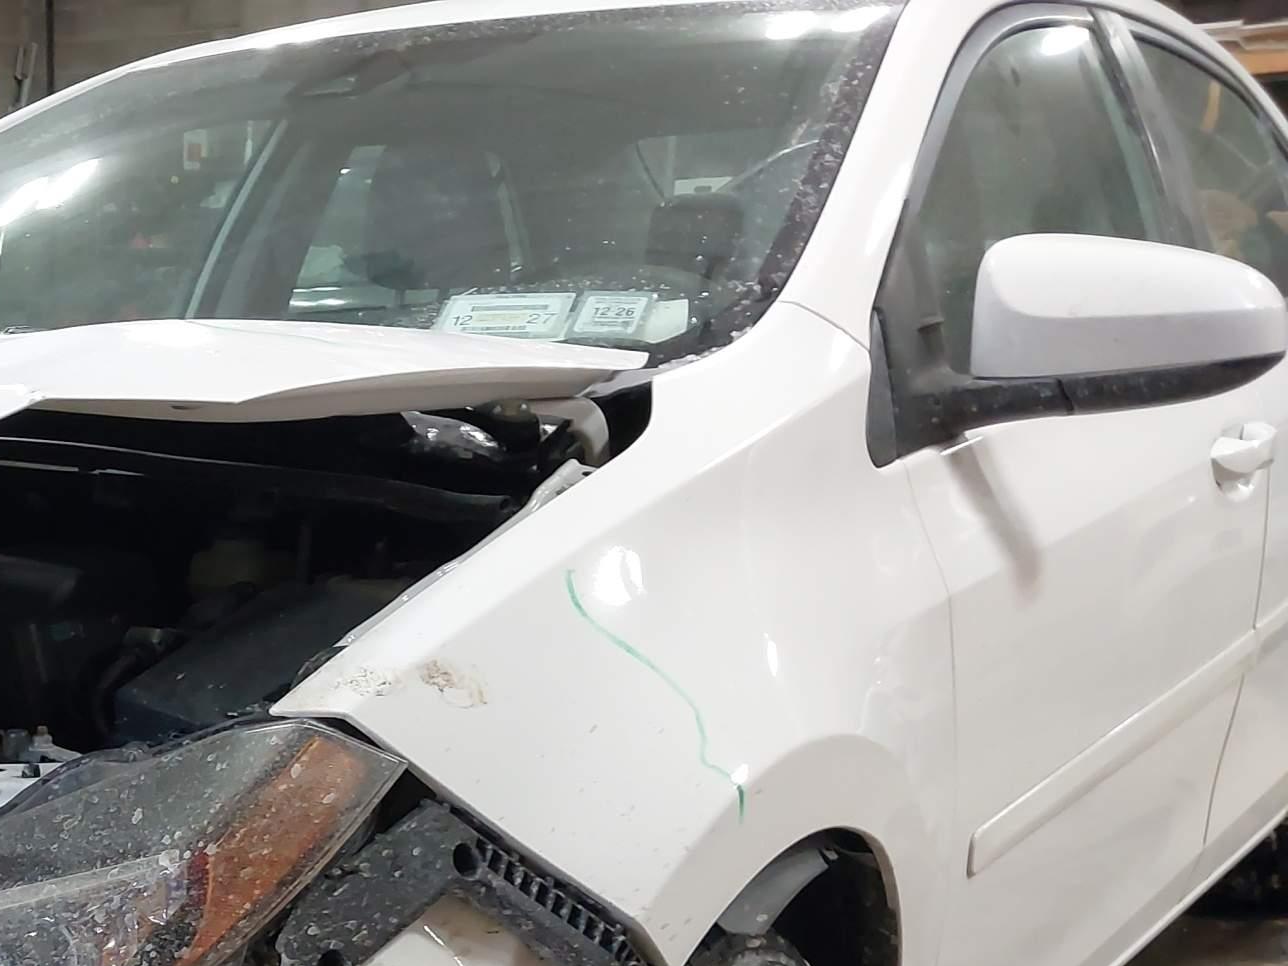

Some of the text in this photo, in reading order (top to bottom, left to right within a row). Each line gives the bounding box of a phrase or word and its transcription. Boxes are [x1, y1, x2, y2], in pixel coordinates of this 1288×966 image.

[592, 306, 637, 317] 12 26
[451, 312, 559, 327] 12 27
